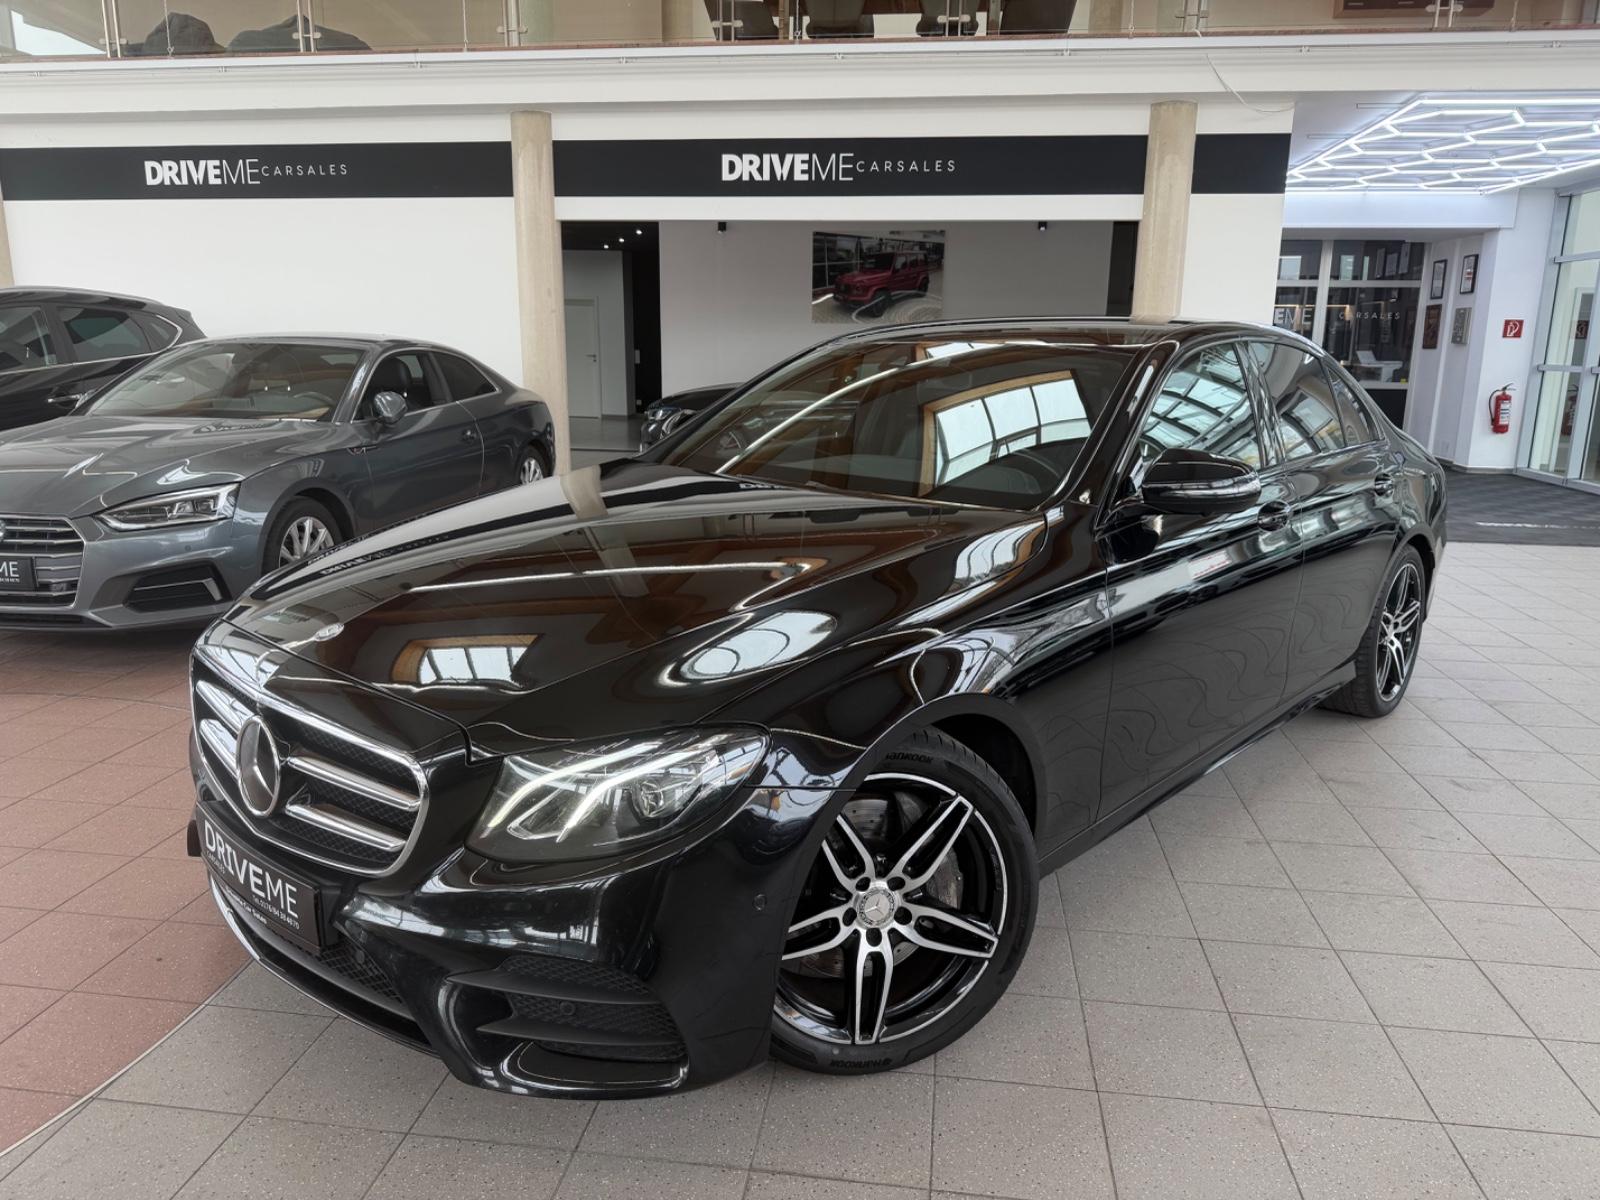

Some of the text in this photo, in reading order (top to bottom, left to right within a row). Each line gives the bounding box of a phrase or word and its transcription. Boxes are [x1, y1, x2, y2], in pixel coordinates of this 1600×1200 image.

[144, 158, 347, 185] DRIVEME CARSALES
[721, 153, 956, 181] DRIVEME CARSALES
[1339, 311, 1400, 320] CRSALES
[204, 819, 298, 919] DRIVEME
